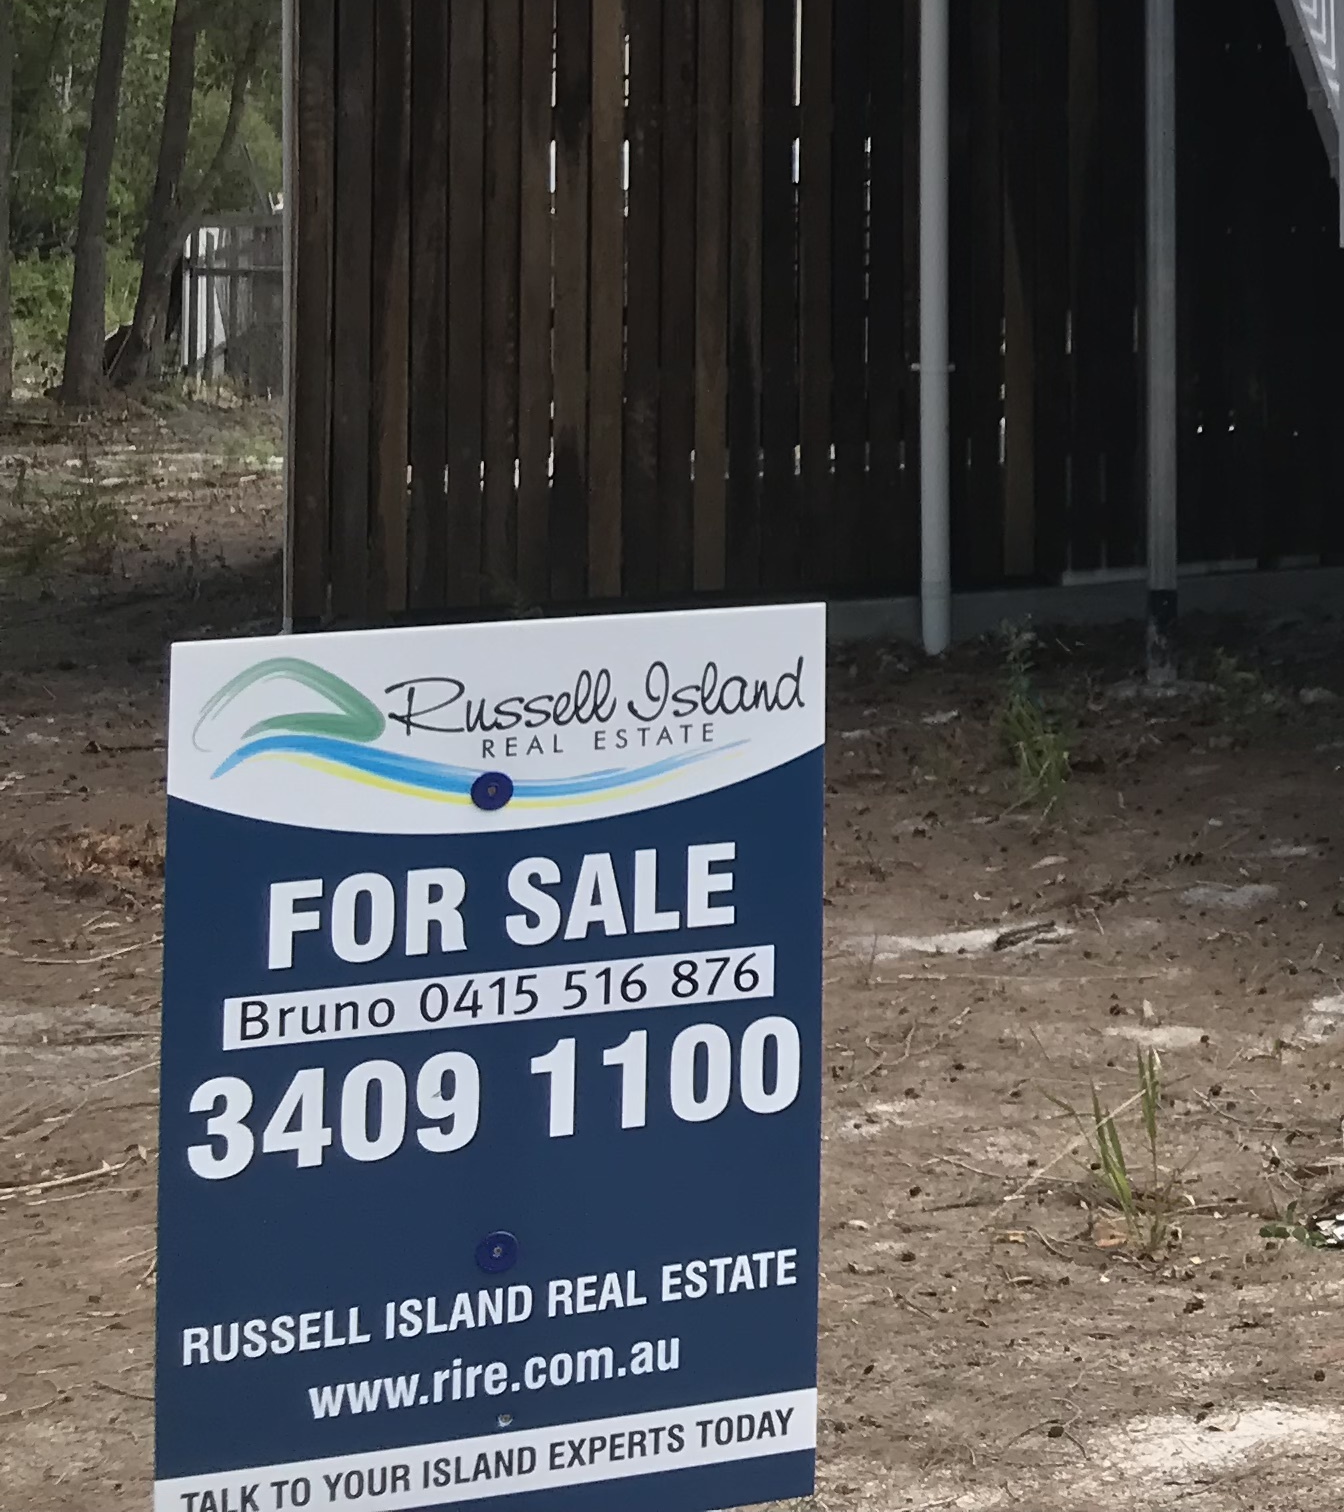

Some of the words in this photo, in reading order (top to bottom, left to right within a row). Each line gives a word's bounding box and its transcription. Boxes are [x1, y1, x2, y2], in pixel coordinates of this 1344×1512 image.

[384, 669, 617, 737] Russell
[627, 656, 806, 722] Island
[482, 733, 564, 759] REAL
[595, 721, 716, 751] ESTATE
[268, 867, 468, 970] FOR
[505, 841, 736, 946] SALE
[240, 998, 396, 1042] Bruno
[420, 974, 539, 1022] 0415
[562, 963, 647, 1010] 516
[672, 952, 760, 999] 876
[187, 1050, 481, 1180] 3409
[530, 1015, 801, 1138] 1100
[182, 1306, 370, 1367] RUSSELL
[385, 1284, 533, 1340] ISLAND
[548, 1269, 647, 1319] REAL
[661, 1248, 798, 1303] ESTATE
[308, 1337, 680, 1420] www.rire.com.au
[180, 1483, 260, 1512] TALK
[270, 1477, 311, 1509] TO
[323, 1464, 410, 1502] YOUR
[422, 1446, 536, 1489] ISLAND
[549, 1423, 685, 1470] EXPERTS
[696, 1407, 794, 1448] TODAY
